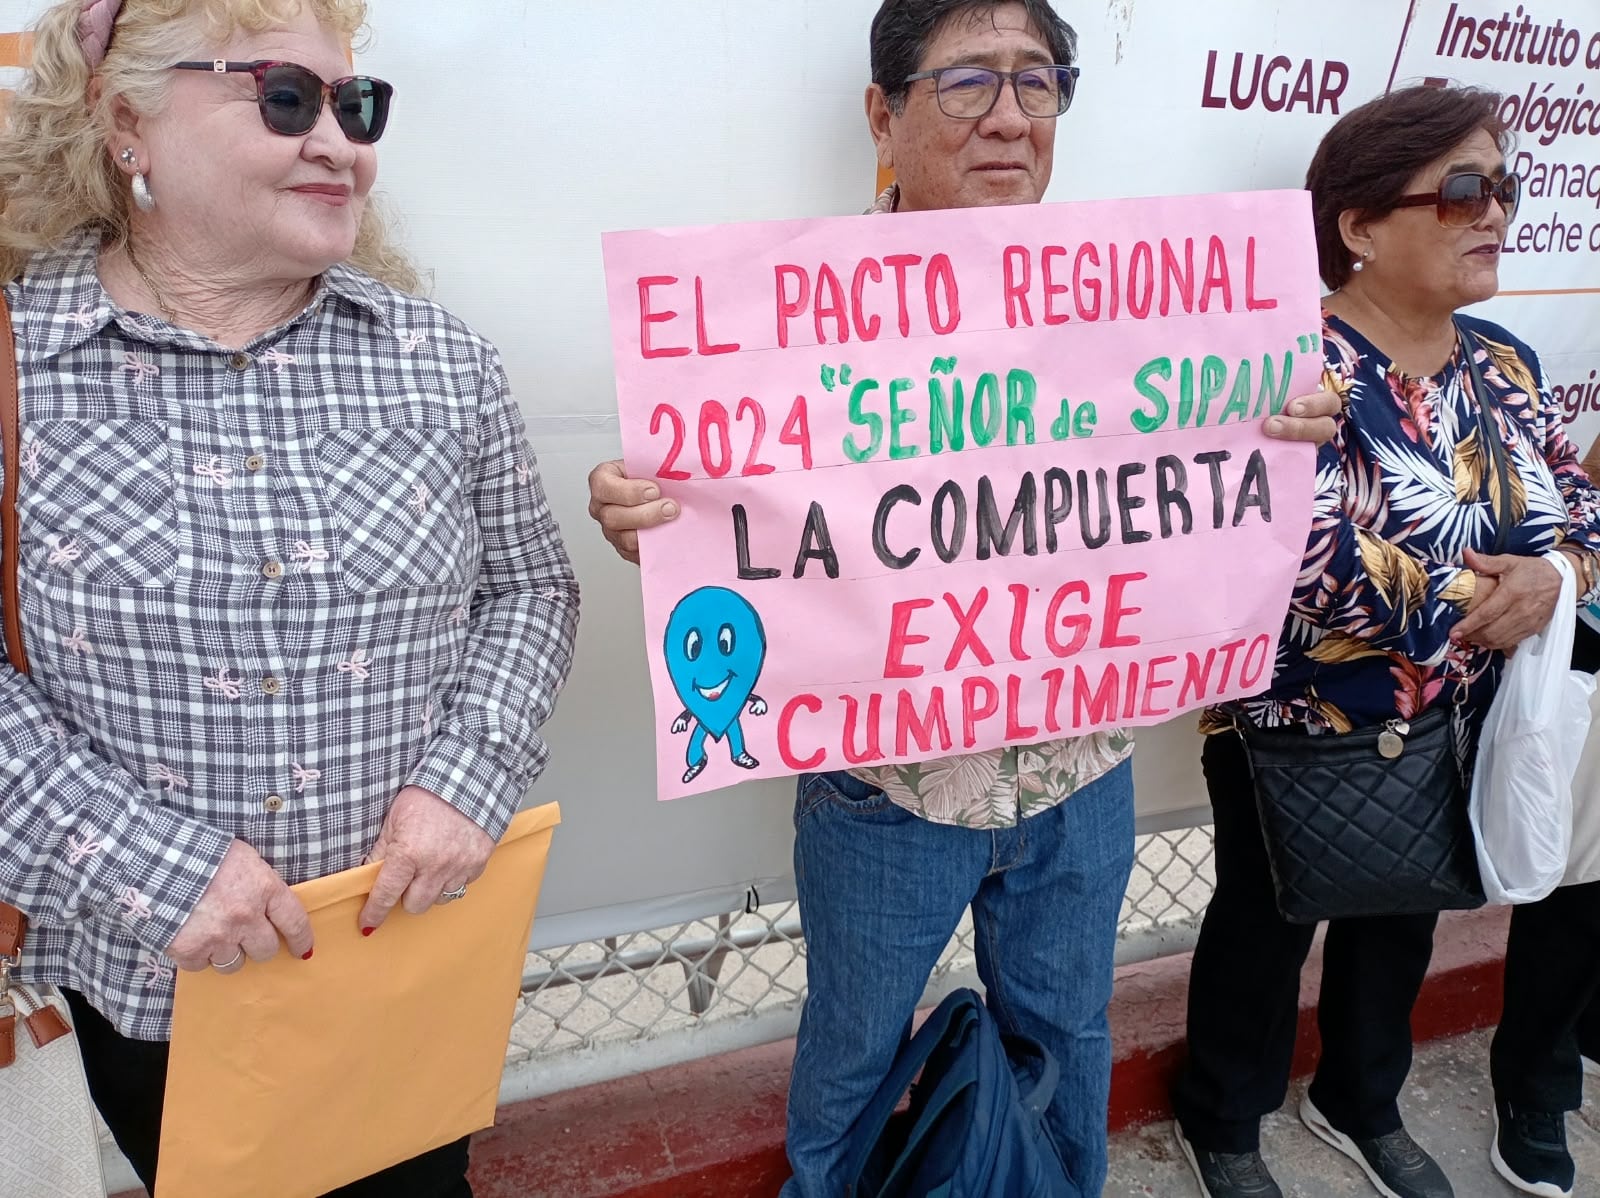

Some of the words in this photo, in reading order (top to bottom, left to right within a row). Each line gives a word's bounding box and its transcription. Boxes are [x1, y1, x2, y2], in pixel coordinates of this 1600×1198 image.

[1201, 50, 1349, 115] LUGAR
[1436, 3, 1580, 67] Instituto
[1500, 211, 1583, 253] Leche
[637, 275, 741, 359] EL
[774, 252, 961, 349] PACTO
[1002, 234, 1278, 329] REGIONAL
[649, 395, 813, 481] 2024
[1051, 397, 1098, 440] de
[733, 500, 840, 580] LA
[871, 449, 1272, 570] COMPUERTA
[883, 571, 1147, 680] EXIGE
[776, 632, 1271, 771] CUMPLIMIENTO
